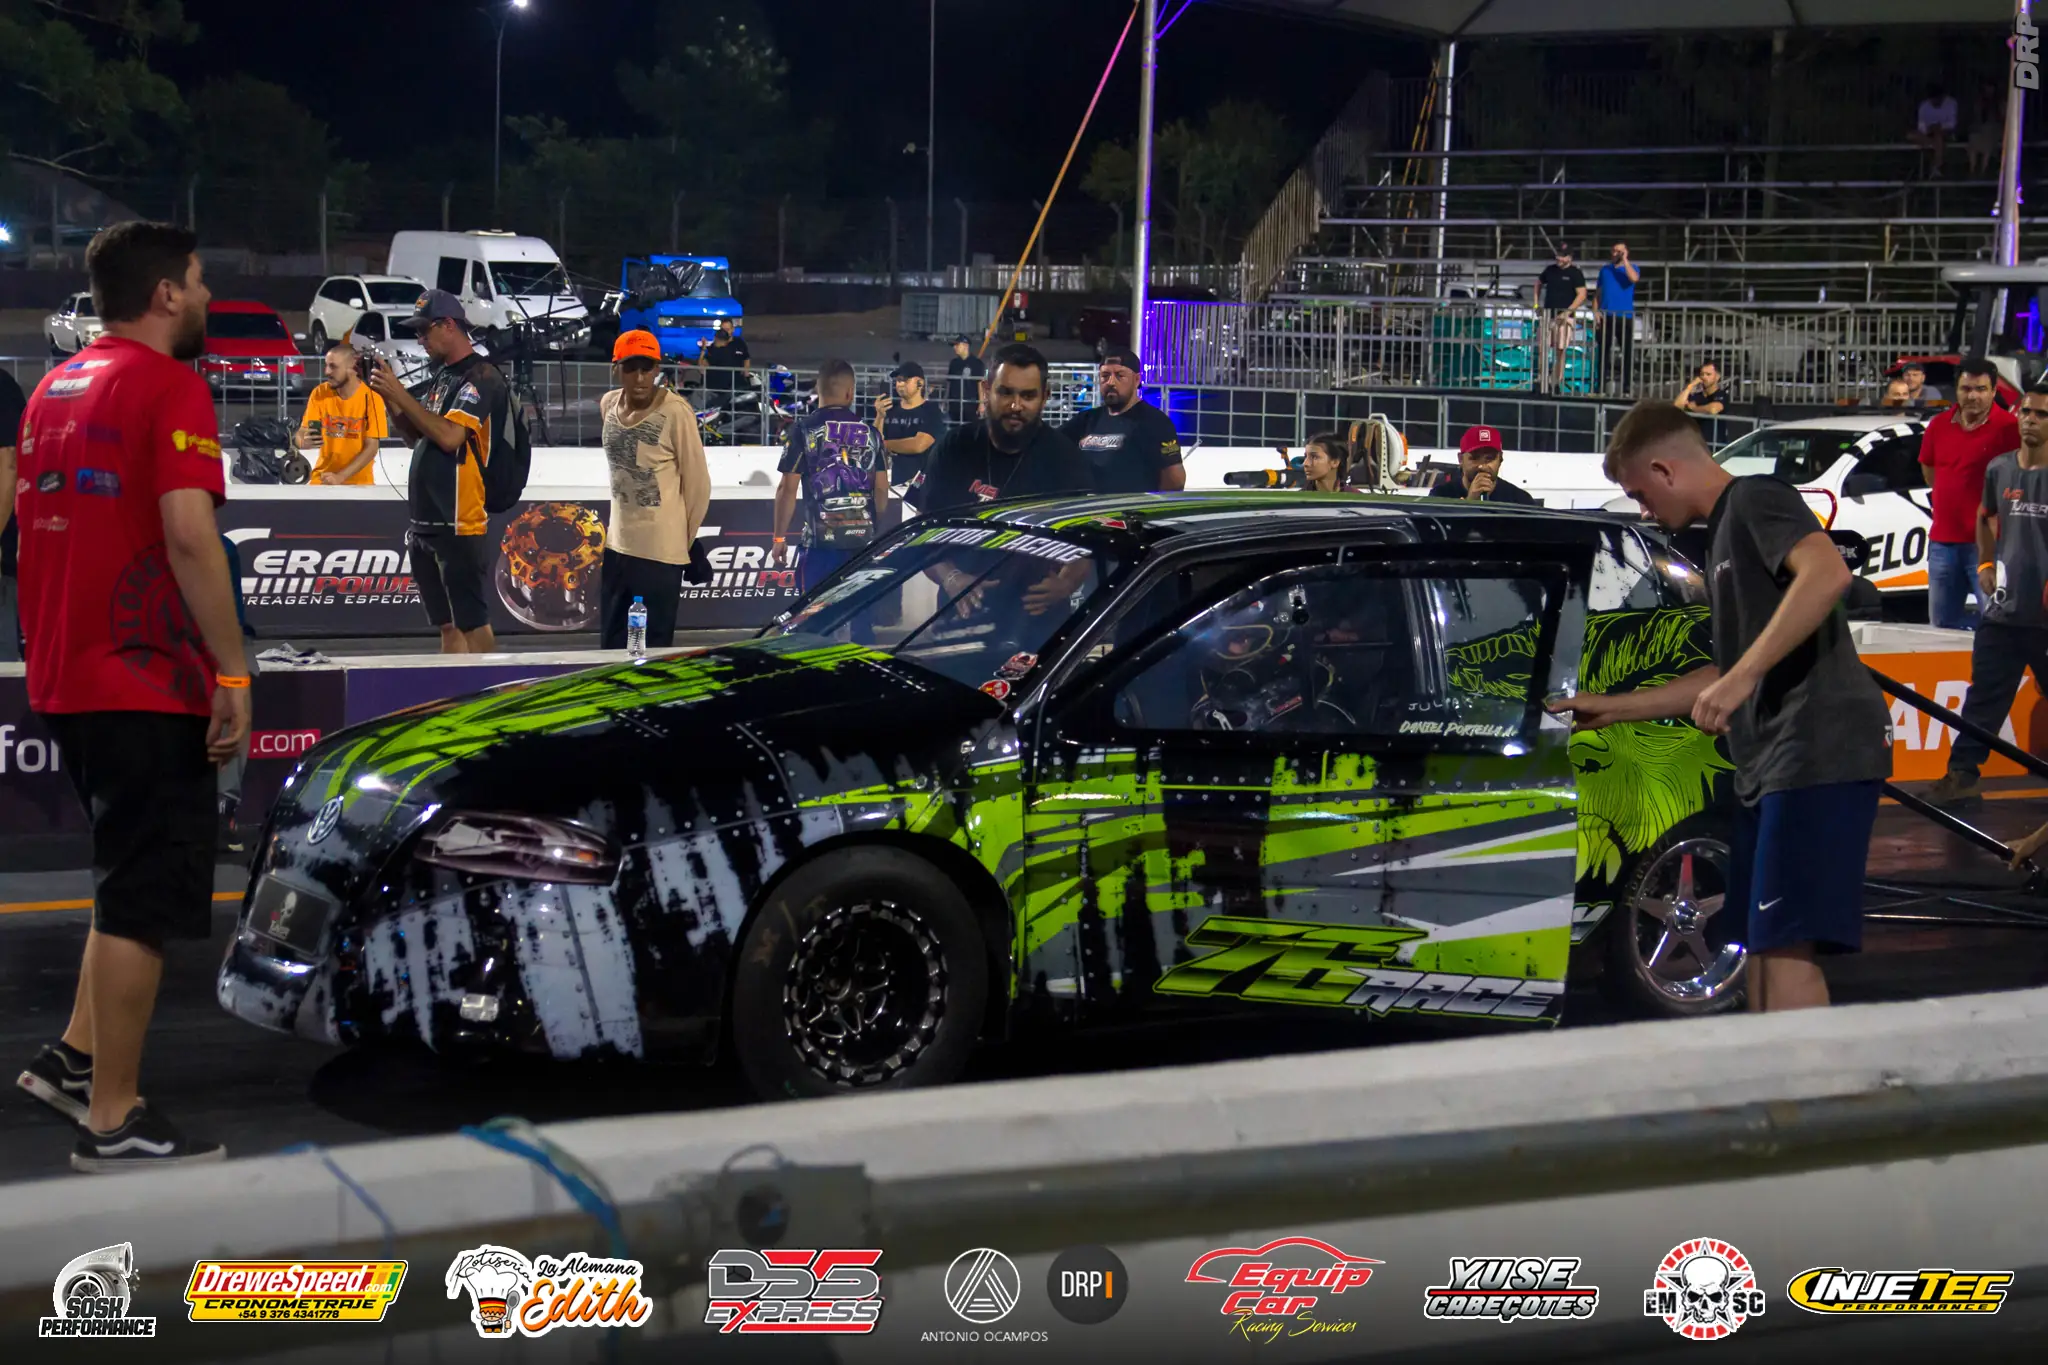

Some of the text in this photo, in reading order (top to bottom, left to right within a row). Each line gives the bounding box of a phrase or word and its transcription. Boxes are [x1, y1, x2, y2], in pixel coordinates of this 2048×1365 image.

[979, 529, 1093, 563] RACING
[1860, 526, 1930, 577] ELO
[312, 576, 420, 594] POWE
[680, 588, 776, 599] MBREAGENS
[242, 594, 421, 606] REAGENS ESPECIA
[1399, 720, 1444, 734] DANIEL
[1344, 966, 1565, 1018] RACE
